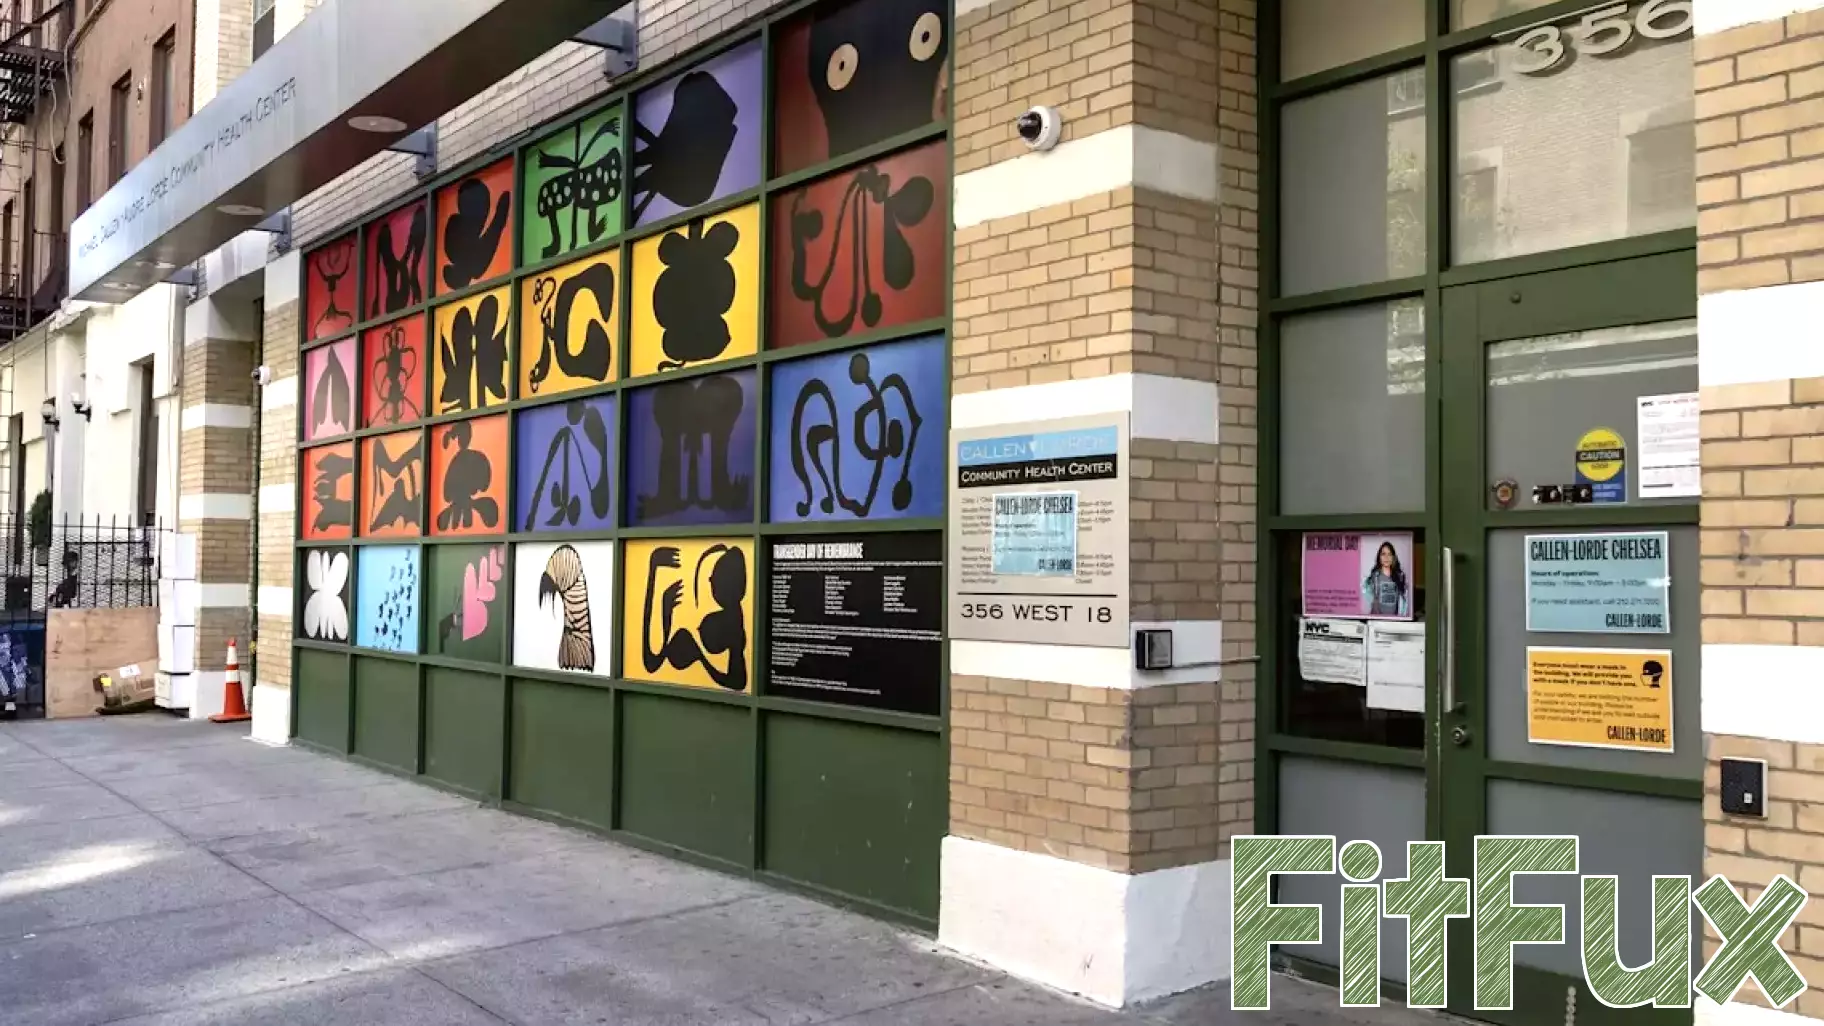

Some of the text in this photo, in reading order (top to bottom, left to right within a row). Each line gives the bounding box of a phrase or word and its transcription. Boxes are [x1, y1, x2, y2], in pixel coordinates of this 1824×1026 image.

[1510, 0, 1694, 75] 356
[171, 140, 215, 188] COMMUNITY
[217, 109, 253, 153] HEALTH
[255, 76, 297, 122] CENTER
[960, 443, 1026, 461] CALLEN
[1580, 450, 1620, 460] CAUTION
[961, 462, 1113, 483] COMMUNITY HEALTH CENTER
[1044, 495, 1073, 514] CHELSEA
[1531, 538, 1662, 561] CALLEN-LORDE CHELSEA
[961, 603, 1113, 624] 356 WEST 18
[1605, 613, 1663, 628] CALLEN-LORDE
[1305, 622, 1330, 634] NYC
[1607, 725, 1667, 744] CALLEN-LORDE
